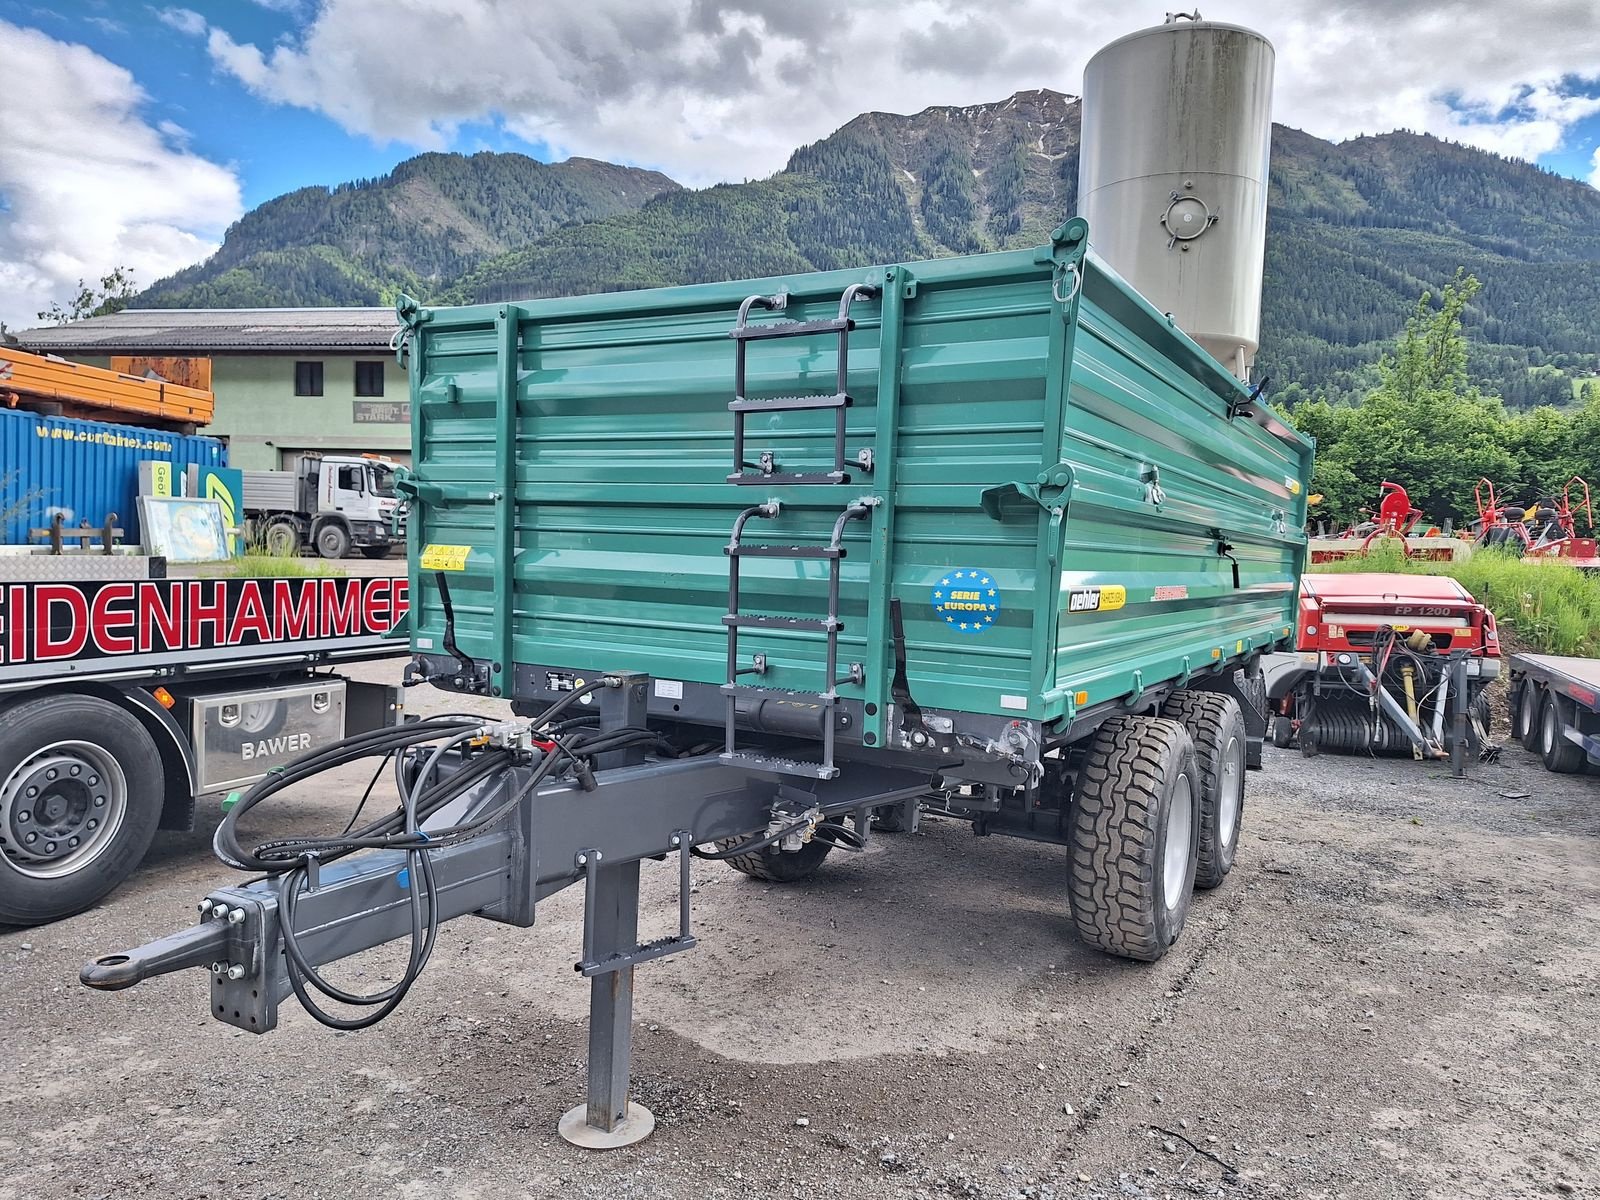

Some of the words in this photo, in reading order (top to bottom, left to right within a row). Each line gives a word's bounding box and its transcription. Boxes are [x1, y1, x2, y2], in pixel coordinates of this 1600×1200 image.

[950, 590, 981, 600] SERIE
[1070, 589, 1100, 611] oehler
[944, 601, 988, 611] EUROPA
[1394, 606, 1412, 615] FP
[1418, 606, 1451, 616] 1200
[0, 577, 411, 664] IDENHAMME
[241, 733, 312, 760] BAWER
